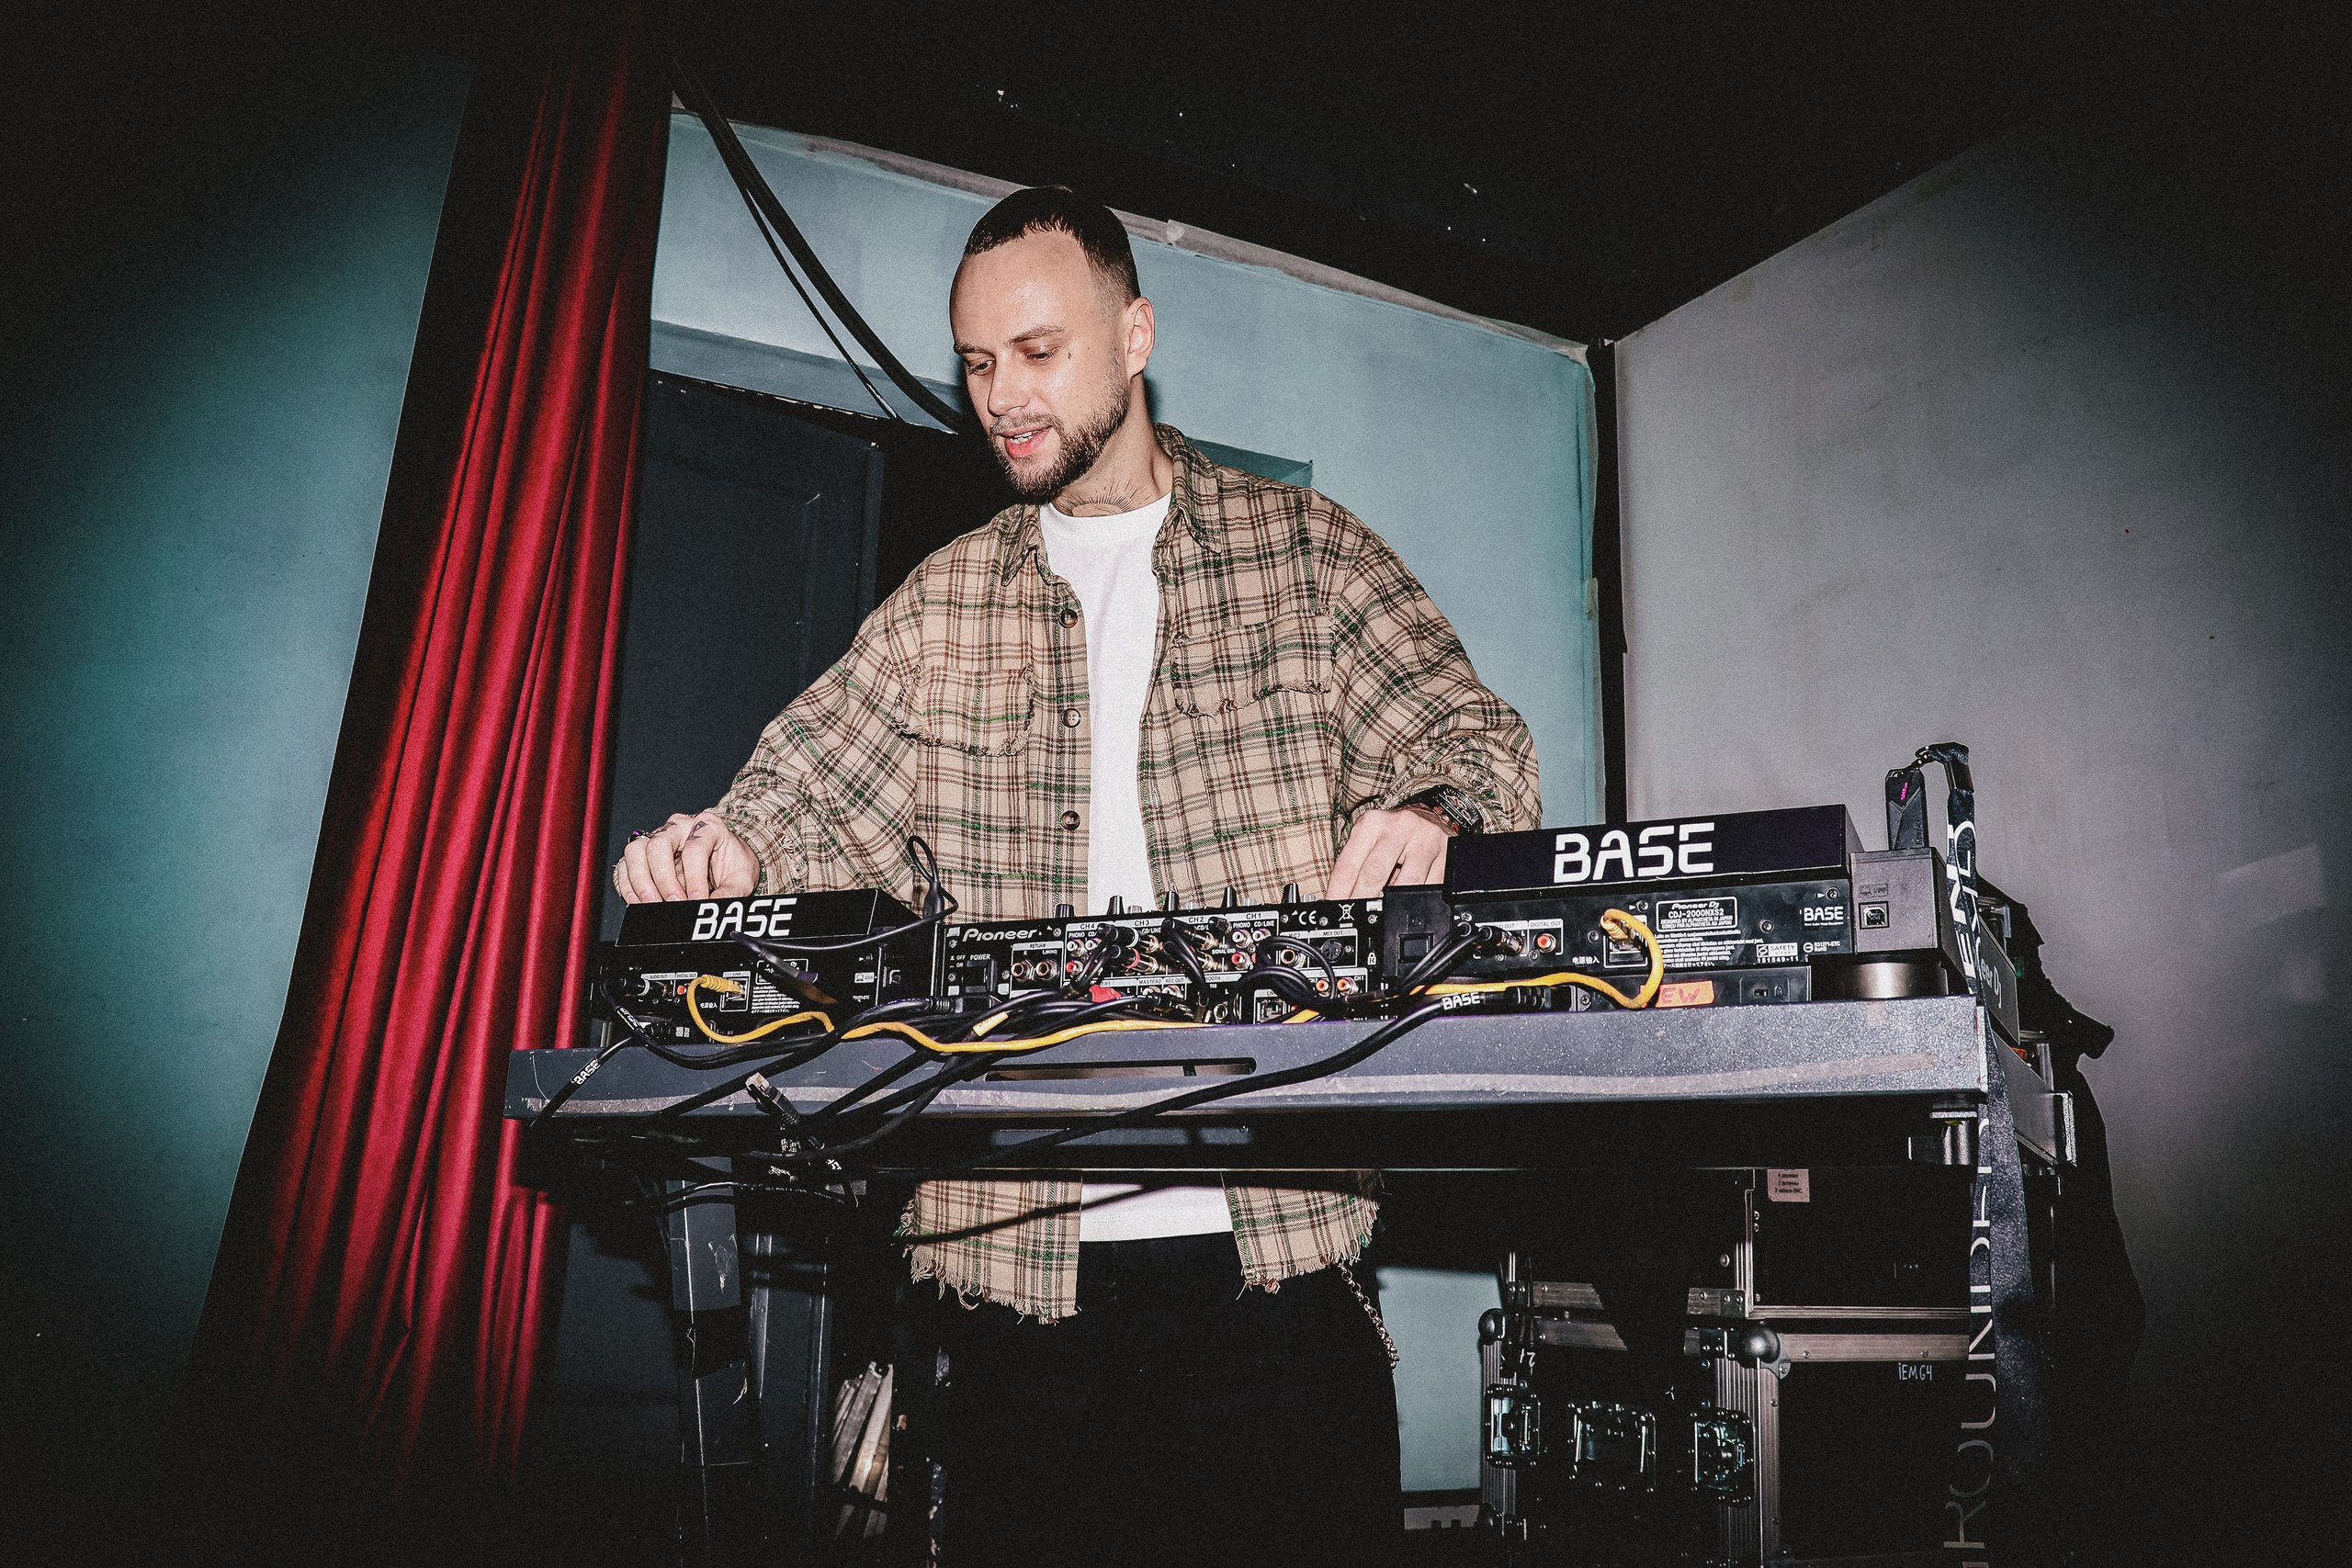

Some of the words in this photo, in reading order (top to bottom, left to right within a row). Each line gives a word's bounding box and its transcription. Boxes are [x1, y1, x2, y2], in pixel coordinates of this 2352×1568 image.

[1554, 822, 1714, 883] BASE
[692, 897, 798, 941] BASE
[1668, 908, 1724, 919] CDJ-2000NXS2
[1804, 906, 1844, 921] BASE
[962, 928, 1038, 942] Pioneer
[1442, 992, 1480, 1010] BASE
[573, 1058, 602, 1085] BASE
